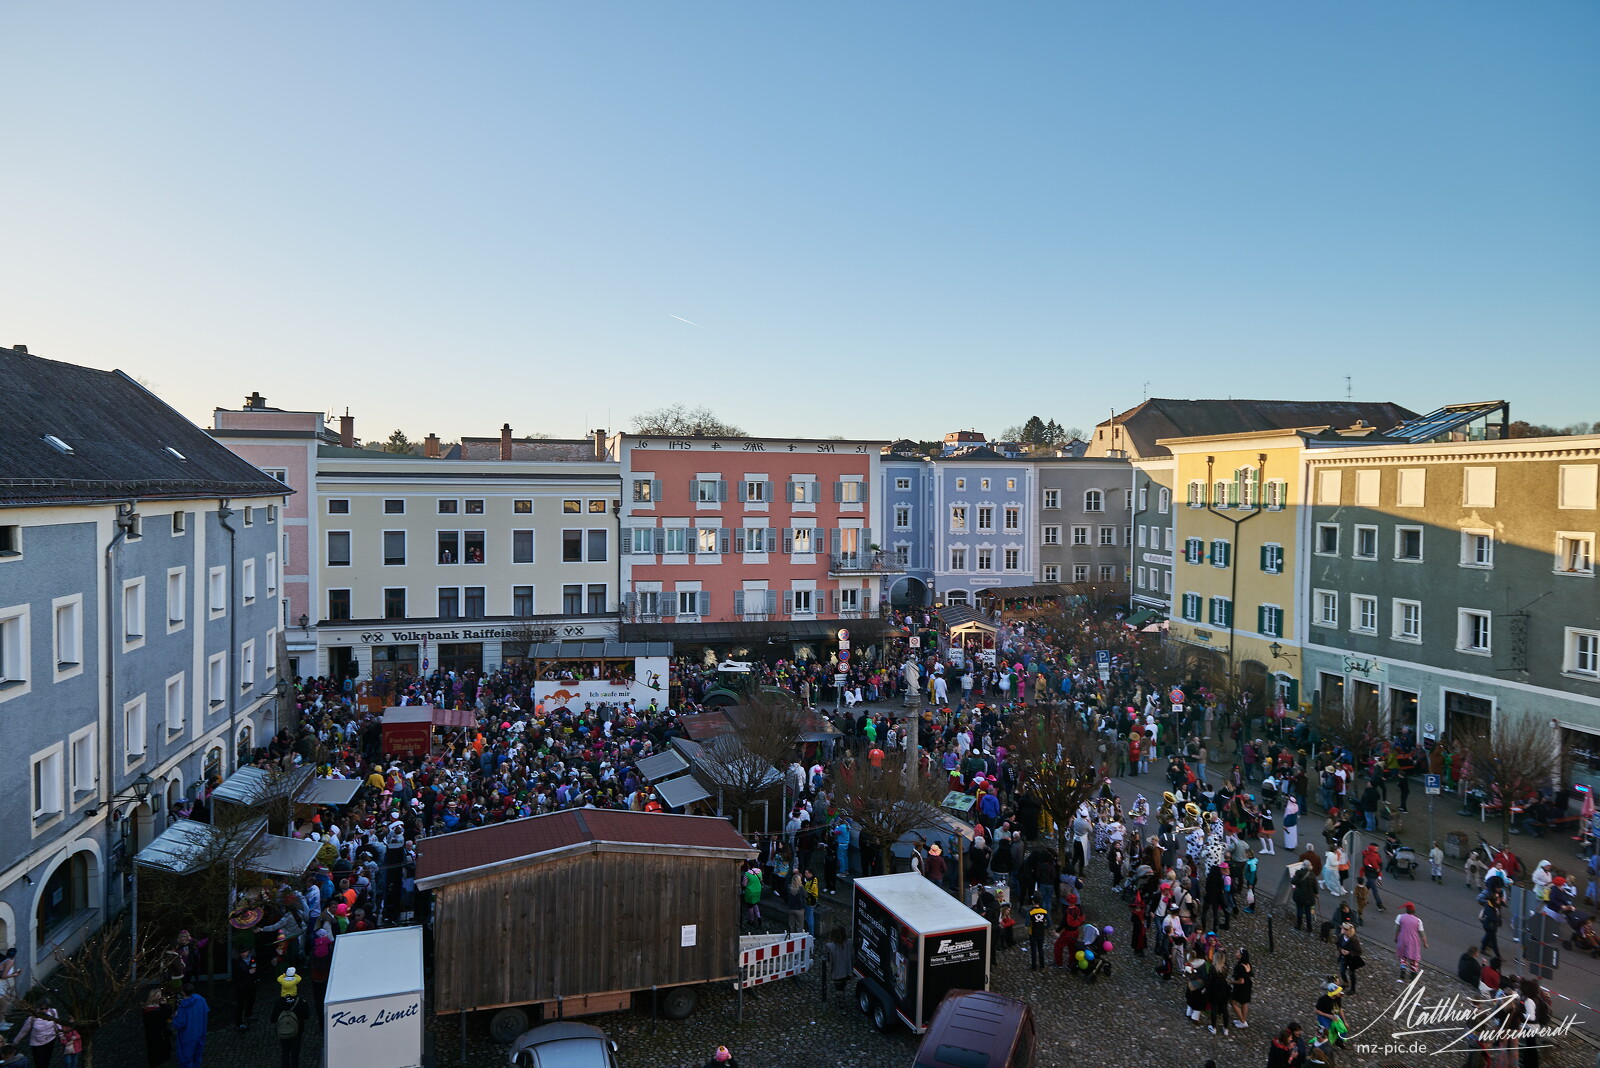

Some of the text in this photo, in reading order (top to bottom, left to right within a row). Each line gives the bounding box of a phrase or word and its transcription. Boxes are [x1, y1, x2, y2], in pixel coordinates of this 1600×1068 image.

[392, 628, 557, 642] Volksbank Raiffeisenbank
[1100, 652, 1106, 661] P
[1428, 776, 1436, 786] P
[331, 1003, 418, 1028] Koa Limit
